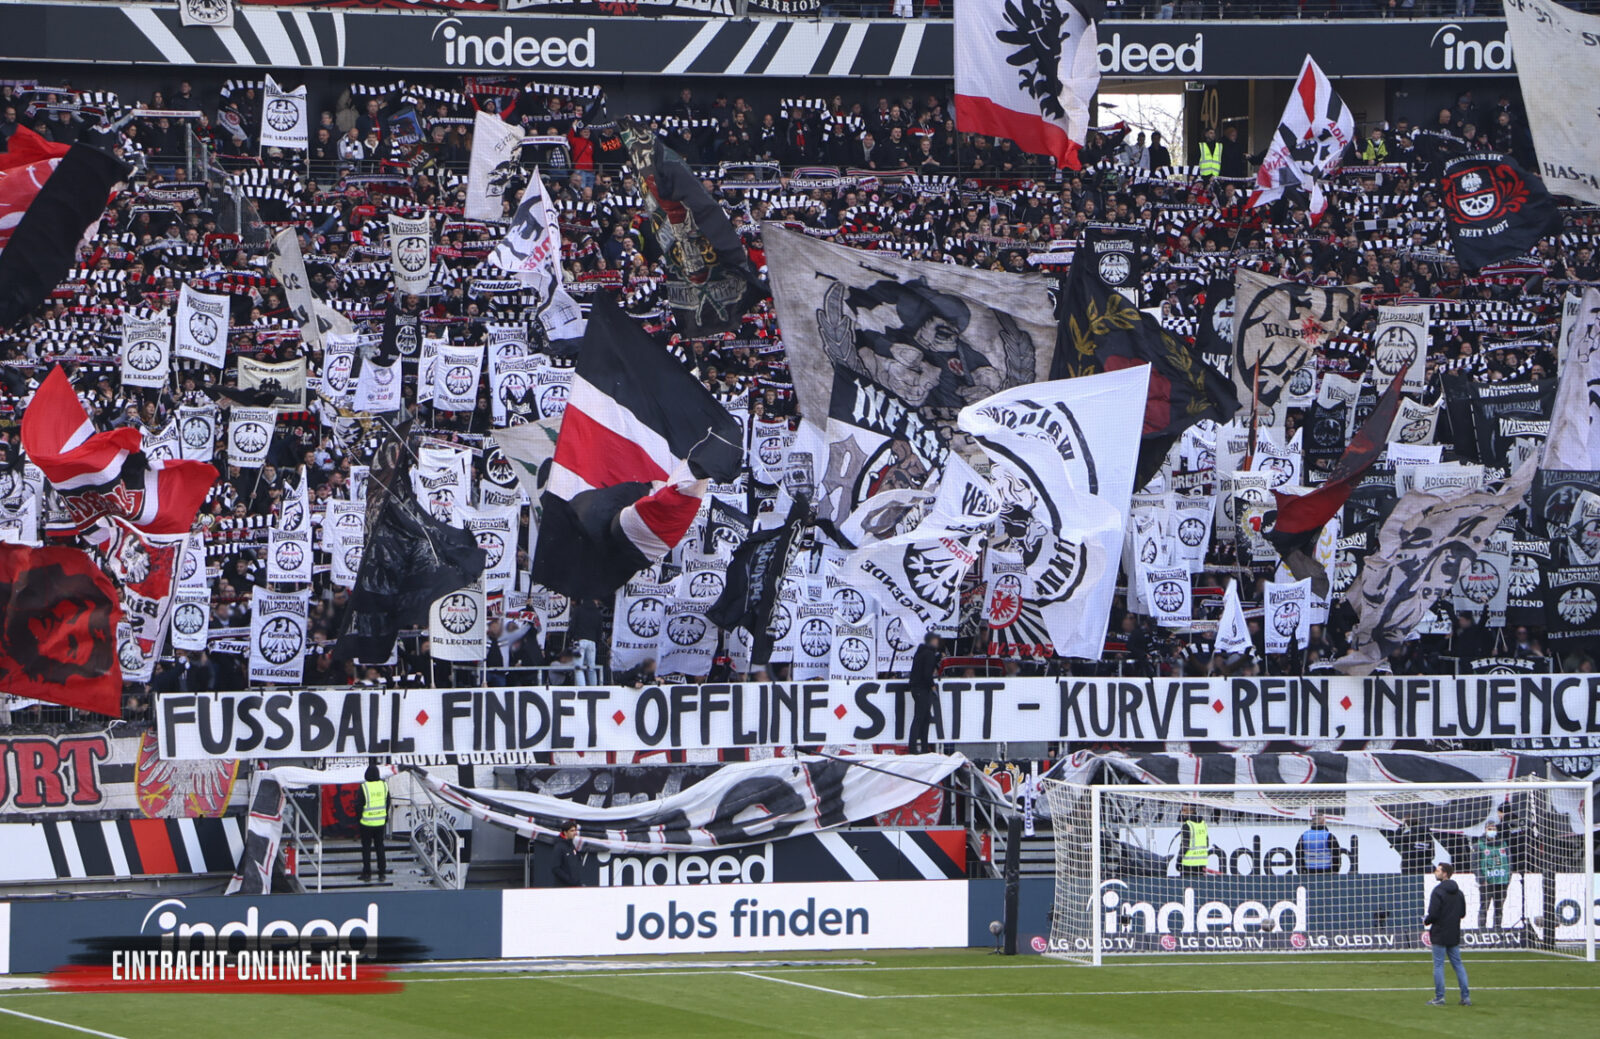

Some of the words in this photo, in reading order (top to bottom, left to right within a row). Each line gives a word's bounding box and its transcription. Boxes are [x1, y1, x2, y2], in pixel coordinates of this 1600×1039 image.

[443, 25, 596, 68] indeed
[1097, 32, 1203, 73] deed
[1442, 29, 1515, 71] ind
[1200, 87, 1219, 128] 40
[275, 134, 309, 142] LEGENDE
[1327, 121, 1349, 147] ADLE
[1459, 228, 1484, 238] SEIT
[1486, 220, 1510, 235] 1997
[1499, 418, 1551, 437] WALDSTADI
[259, 600, 307, 617] WALDSTADION
[432, 637, 444, 645] DIE
[446, 638, 483, 646] LEGENDE
[1548, 631, 1563, 639] DIE
[1470, 656, 1536, 671] HIGH
[252, 668, 265, 676] DIE
[266, 669, 300, 678] LEGENDE
[162, 693, 415, 757] FUSSBALL
[441, 690, 611, 752] FINDET
[635, 683, 830, 747] OFFLINE
[1059, 680, 1210, 738] KURVE
[1231, 678, 1347, 739] REIN,
[0, 738, 109, 808] RT
[598, 842, 774, 887] indeed
[615, 899, 717, 941] Jobs
[730, 897, 869, 937] finden
[1101, 886, 1307, 934] indeed
[1050, 938, 1069, 950] LG
[1075, 938, 1113, 950] OLD
[1115, 937, 1135, 948] TV
[1180, 937, 1199, 948] LG
[1204, 936, 1242, 948] OLED
[1244, 936, 1264, 948] TV
[1309, 935, 1329, 947] LG
[1334, 934, 1373, 947] OLED
[1374, 934, 1395, 946] TV
[1463, 932, 1501, 945] OLED
